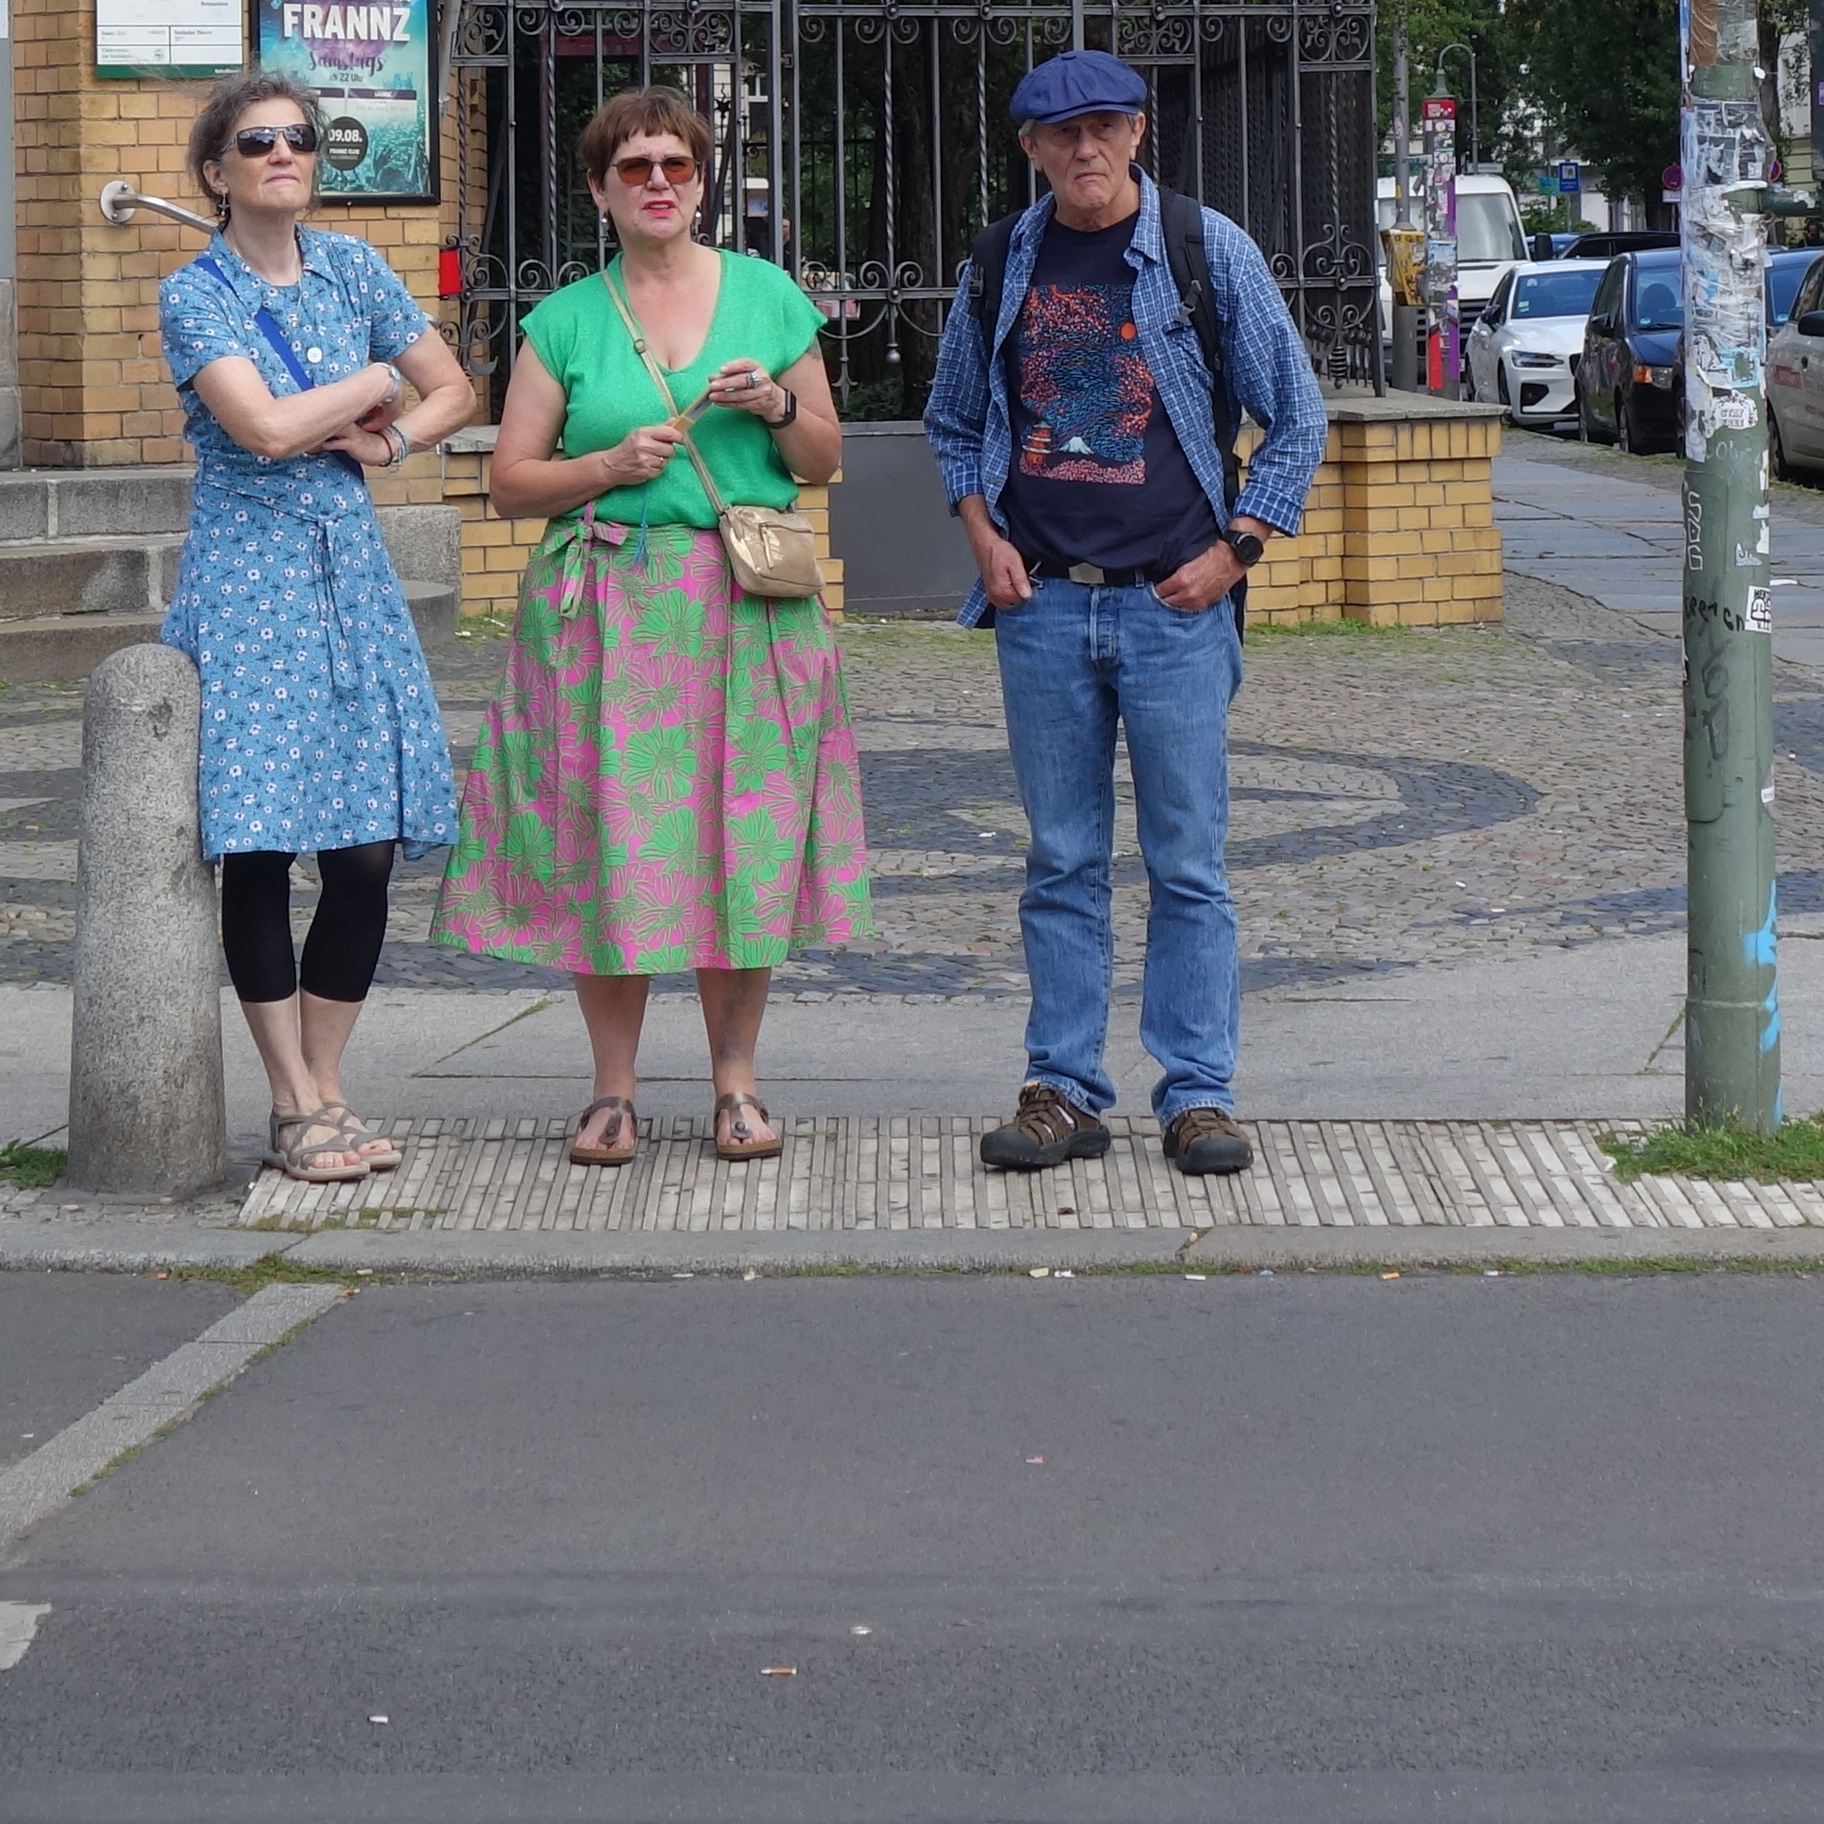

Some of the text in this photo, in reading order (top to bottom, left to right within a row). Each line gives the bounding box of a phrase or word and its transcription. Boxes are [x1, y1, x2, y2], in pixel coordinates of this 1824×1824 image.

[283, 3, 411, 42] FRANNZ
[339, 73, 350, 83] 22
[350, 73, 364, 83] Uhr
